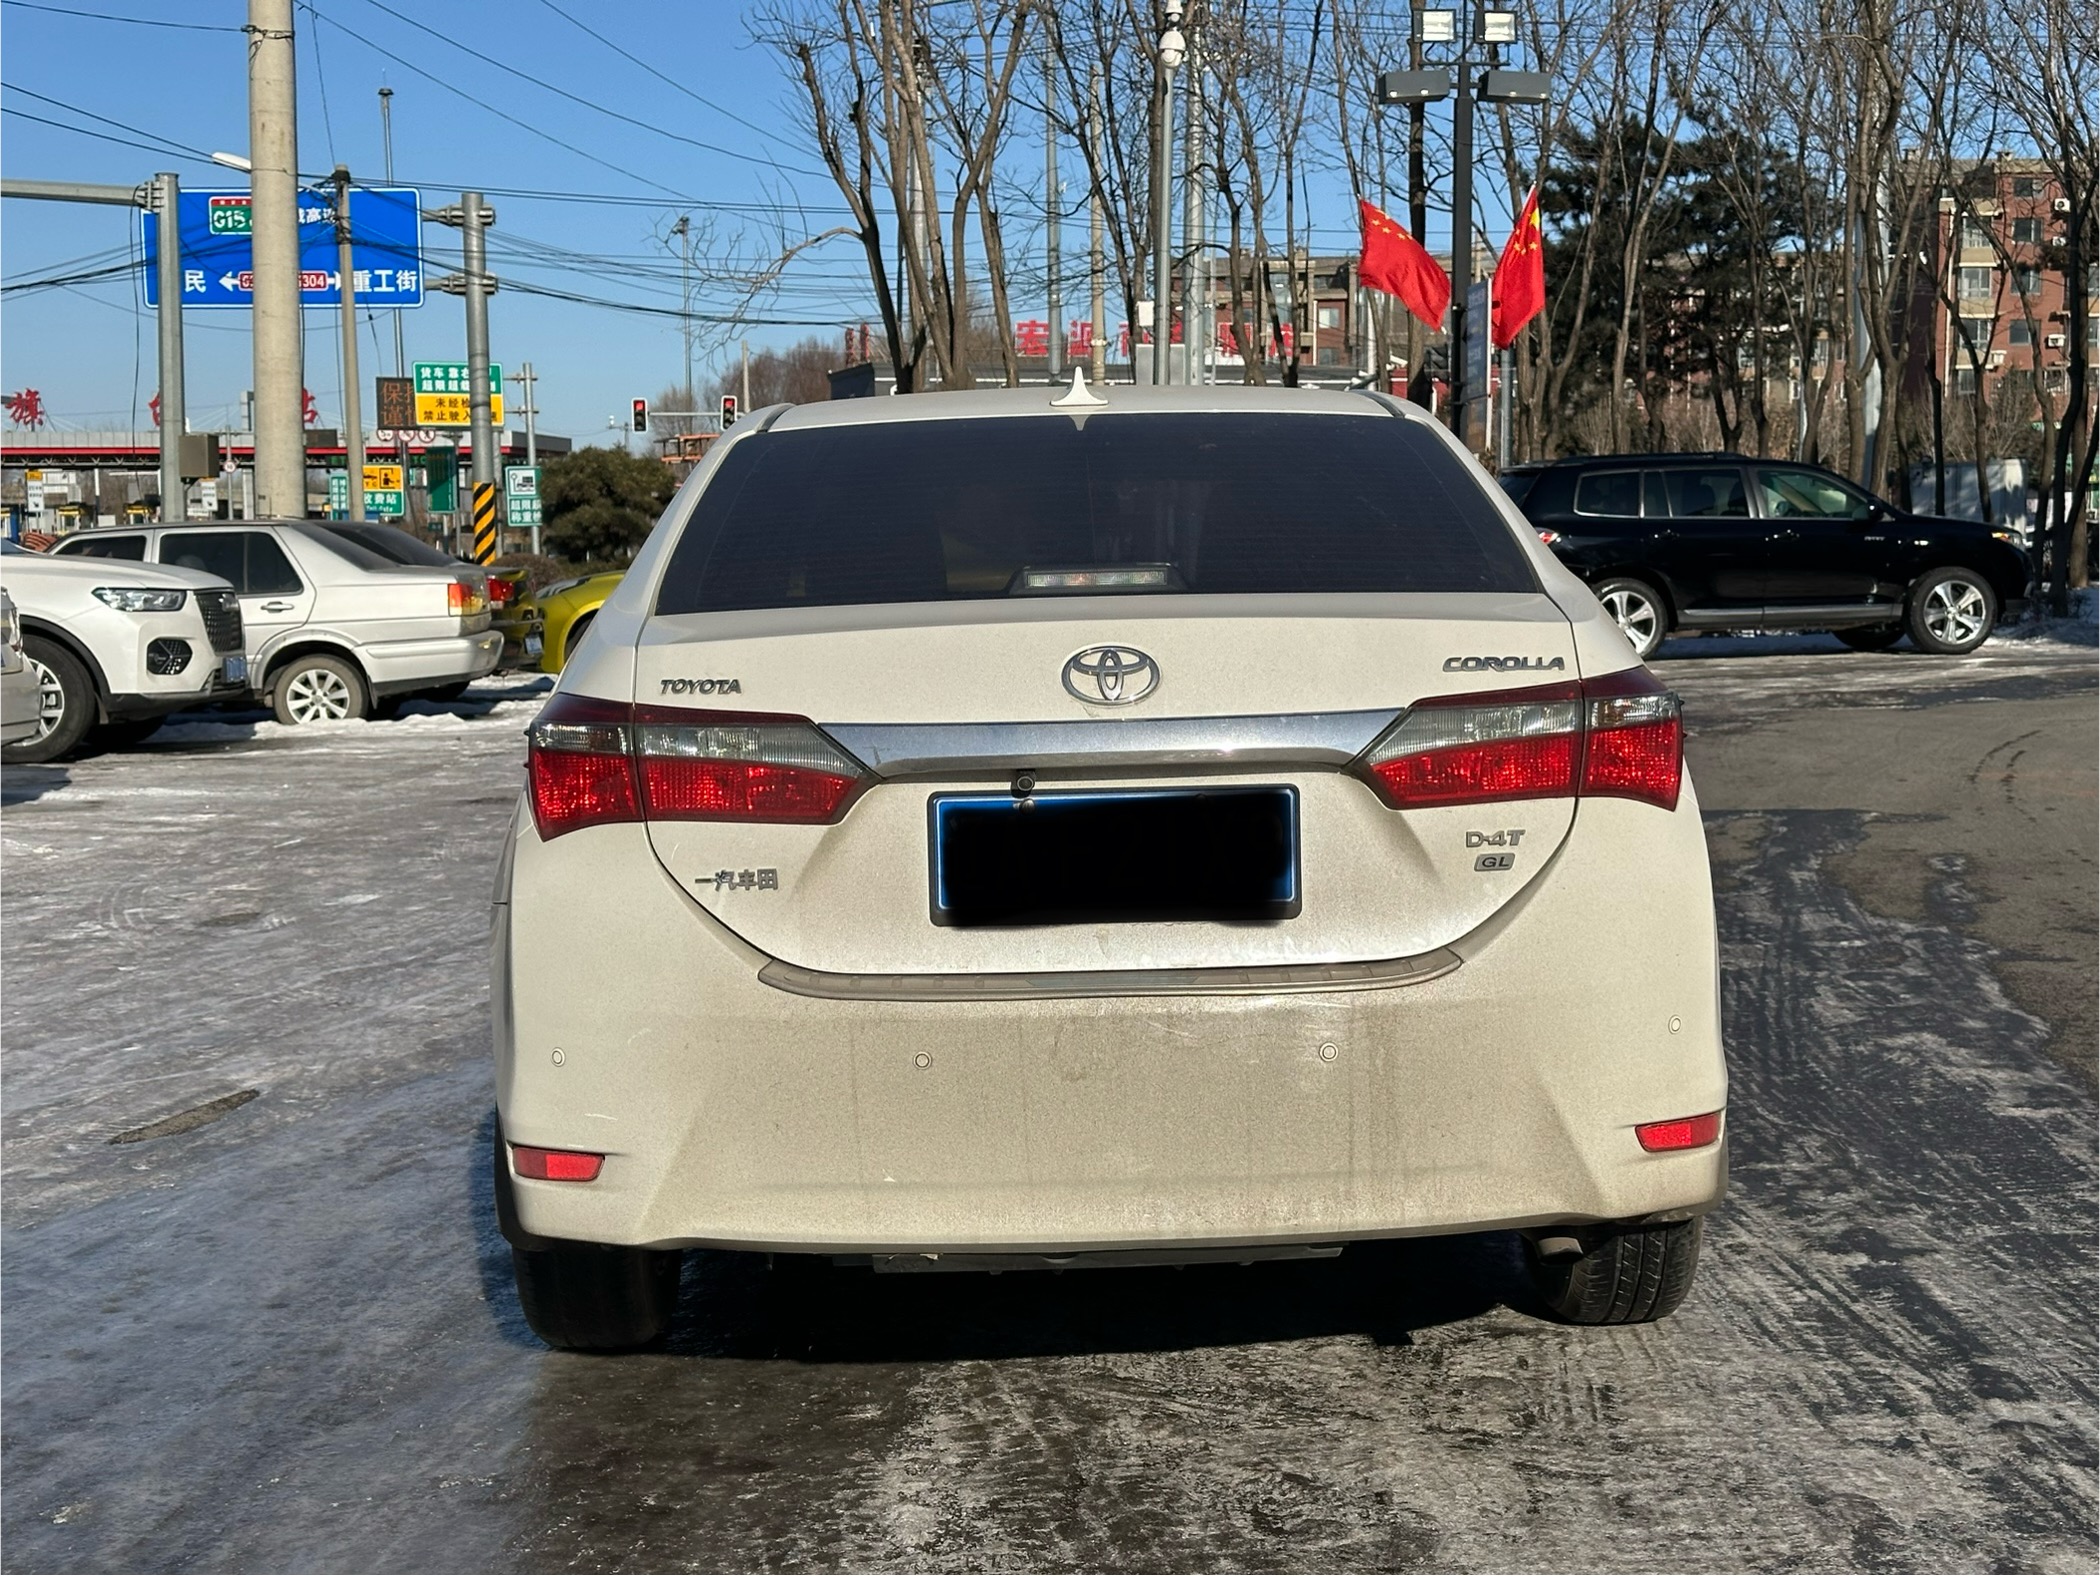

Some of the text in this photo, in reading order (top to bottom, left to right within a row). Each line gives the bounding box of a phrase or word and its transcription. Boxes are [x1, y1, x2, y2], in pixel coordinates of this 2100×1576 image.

[353, 269, 418, 292] 重工街
[1443, 656, 1565, 672] COROLLA
[660, 679, 742, 695] TOYOTA
[1466, 829, 1526, 848] D-4T
[1481, 855, 1511, 868] GL
[695, 868, 778, 892] 一汽丰田
